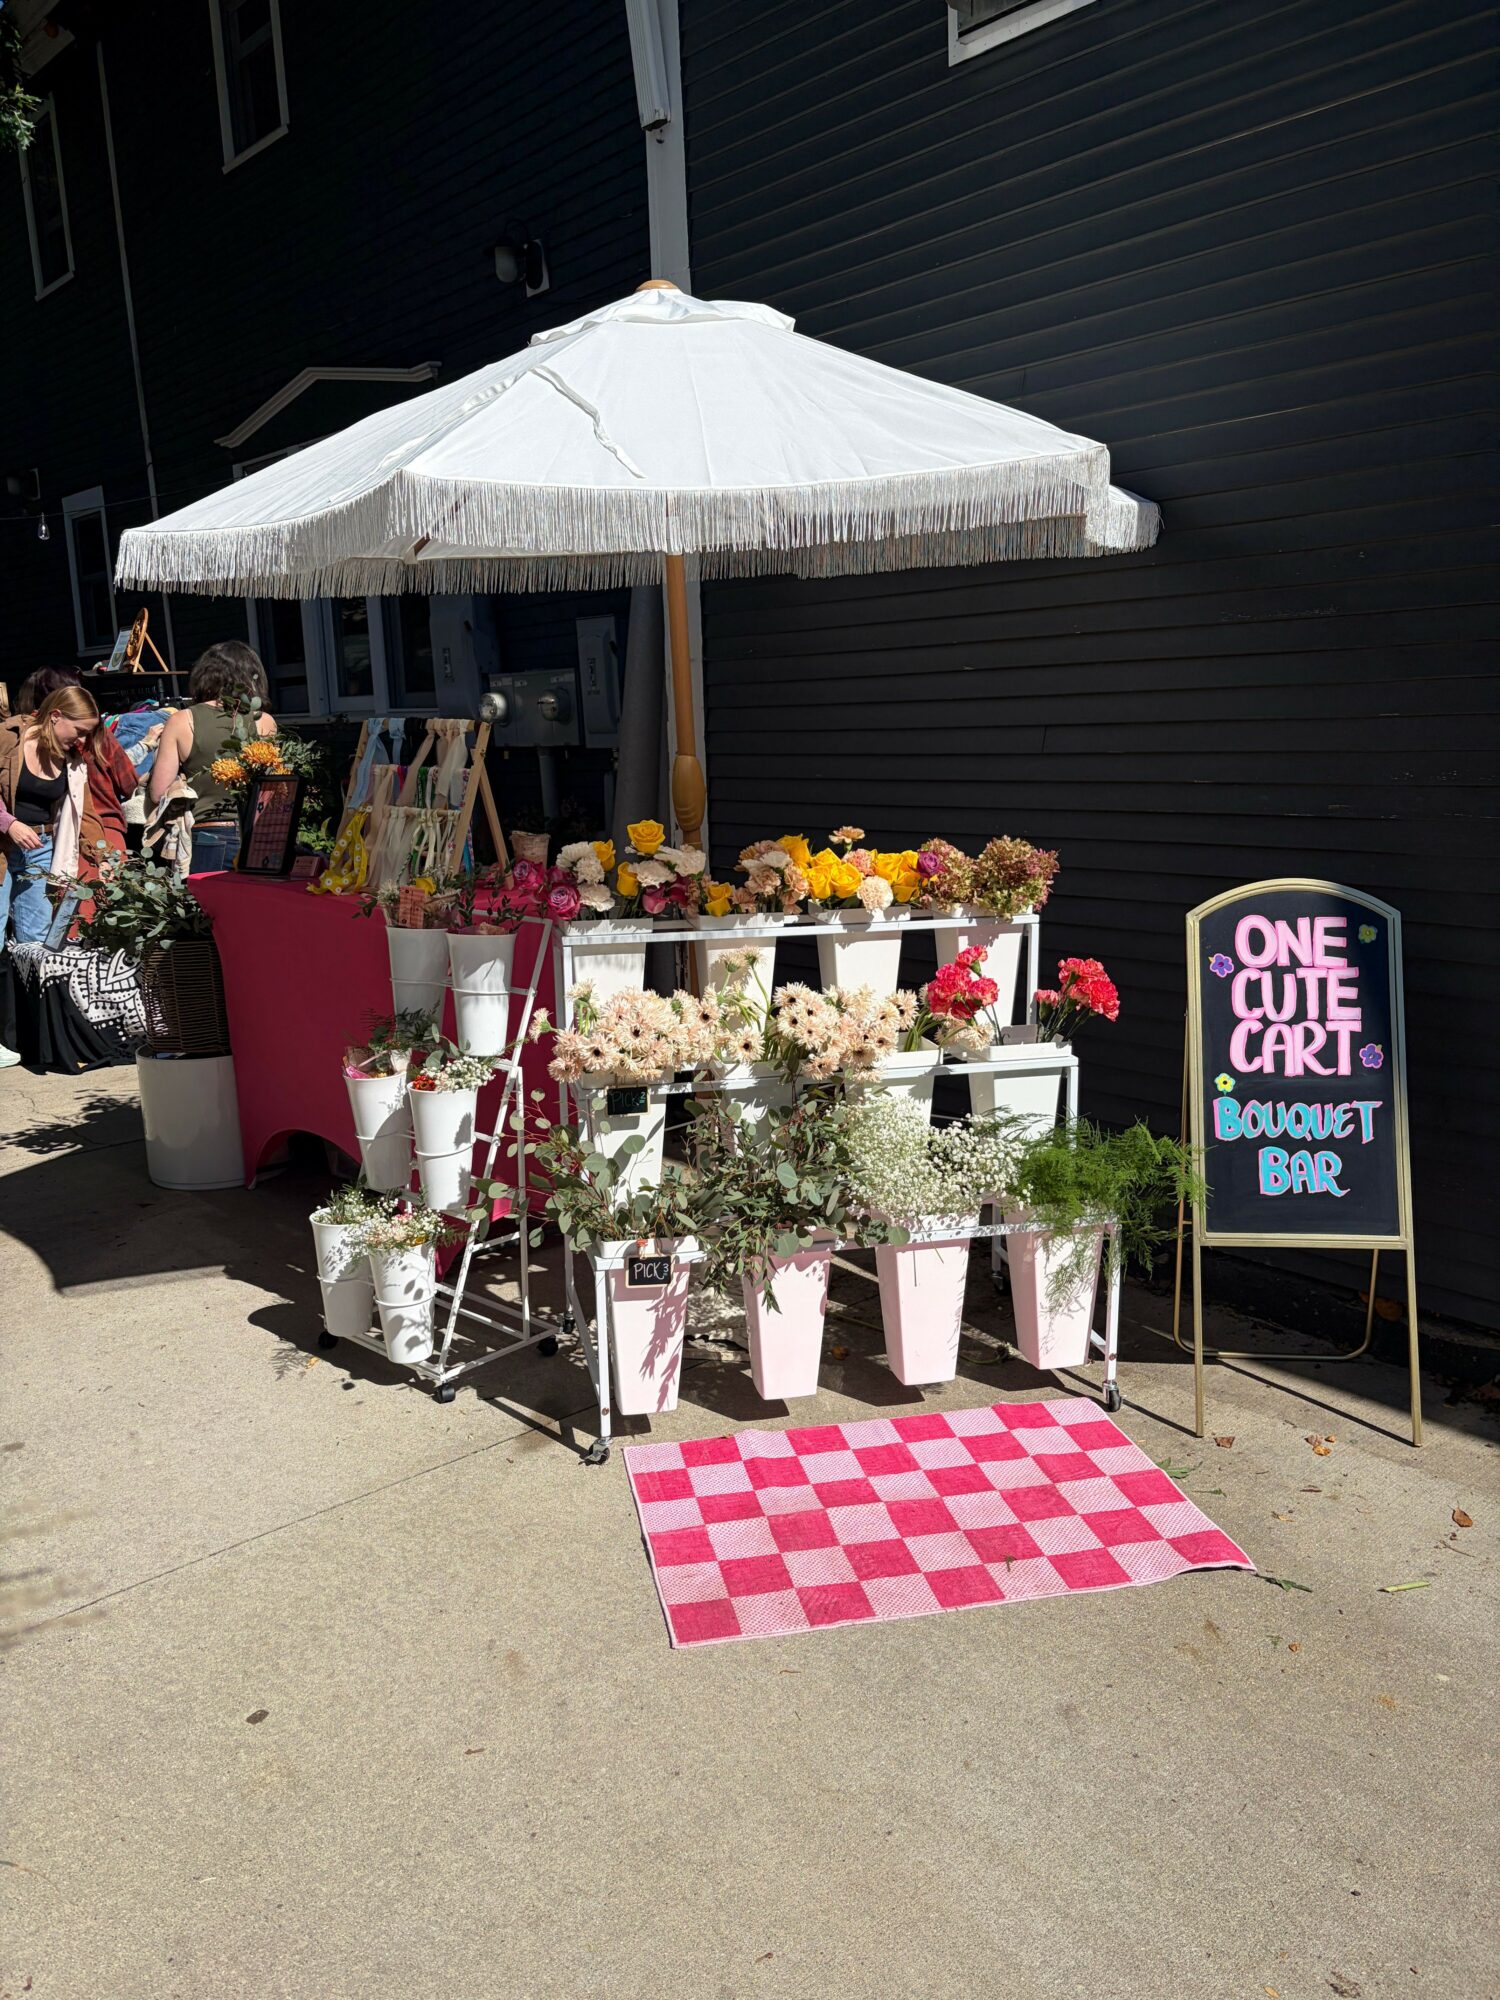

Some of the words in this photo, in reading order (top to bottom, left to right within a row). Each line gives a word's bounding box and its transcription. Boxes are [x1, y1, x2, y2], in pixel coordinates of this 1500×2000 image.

[1235, 915, 1348, 968] ONE
[1232, 967, 1362, 1022] CUTE
[1229, 1018, 1362, 1077] CART
[1213, 1096, 1383, 1144] BOUQUET
[1259, 1146, 1351, 1197] BAR
[633, 1261, 664, 1280] PICK
